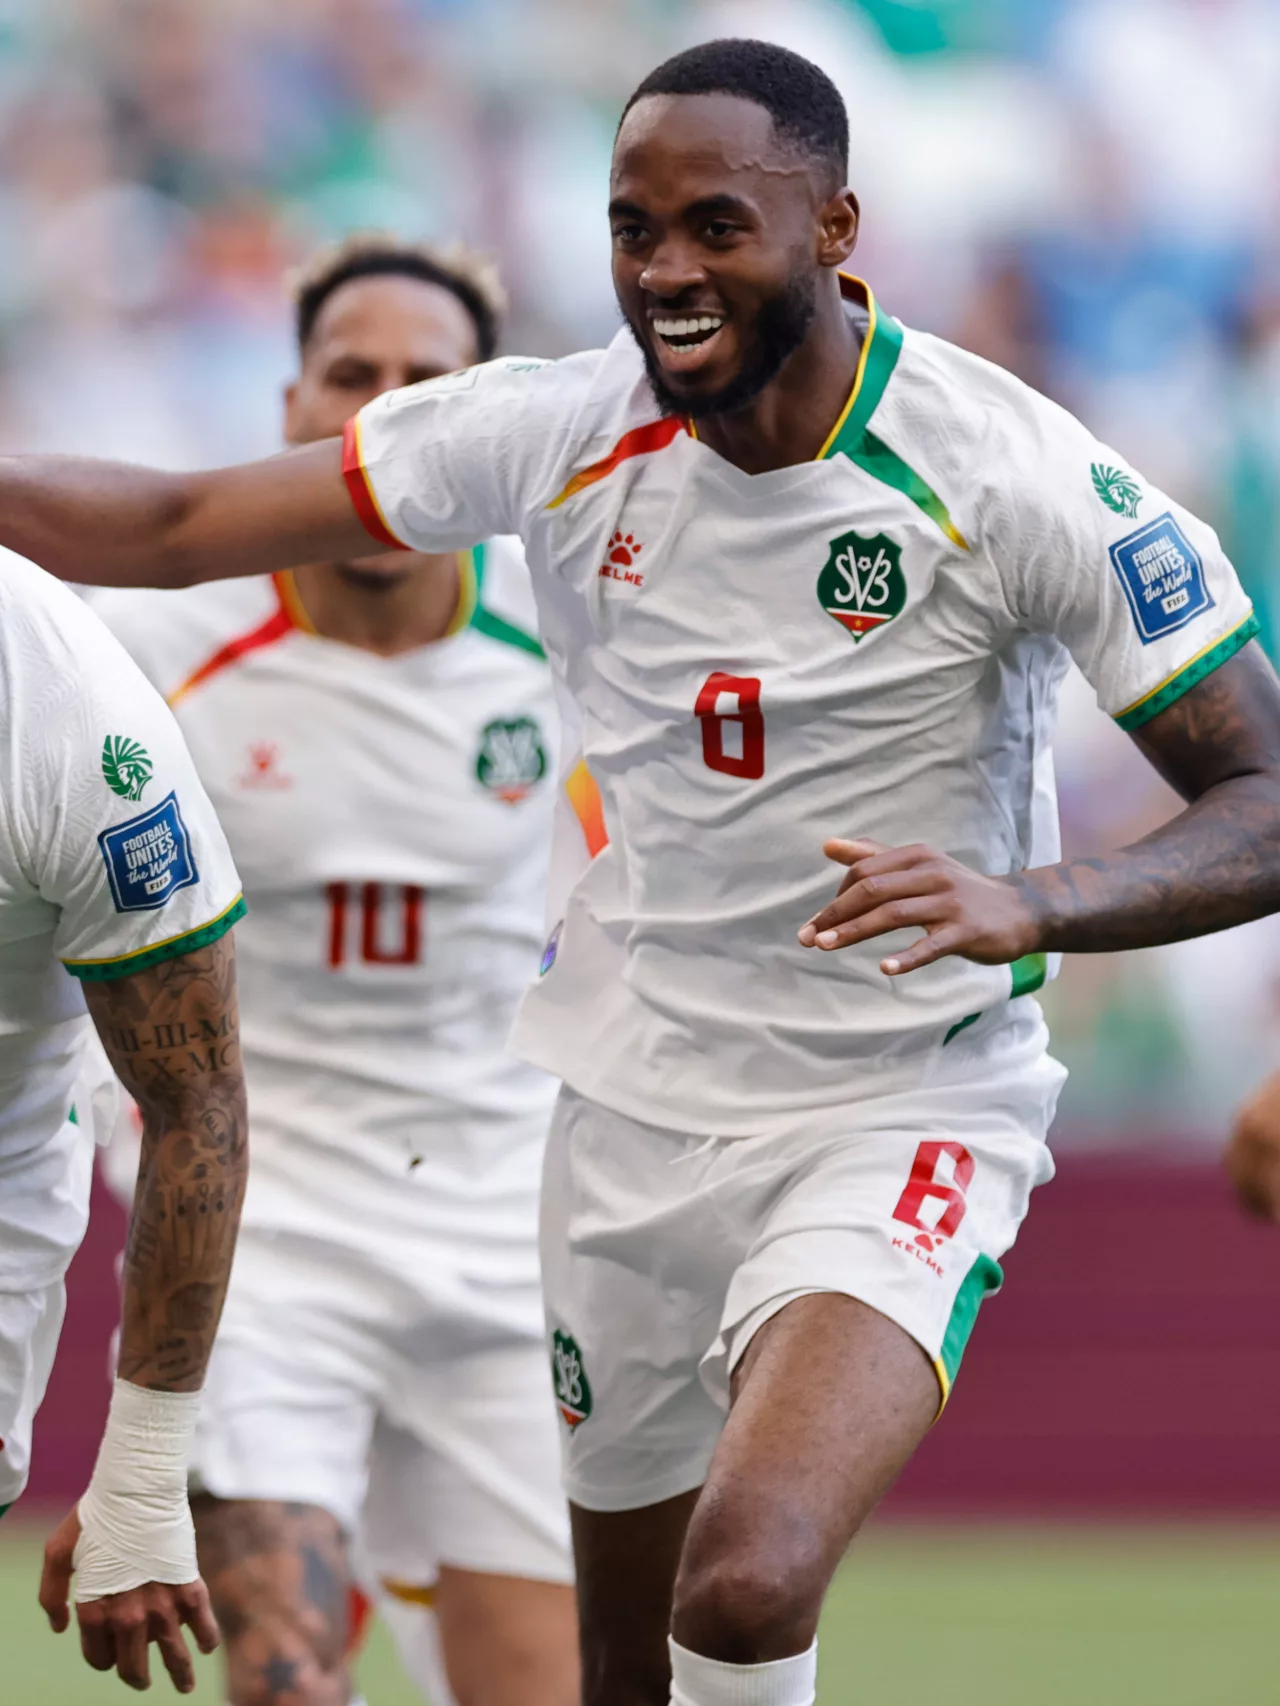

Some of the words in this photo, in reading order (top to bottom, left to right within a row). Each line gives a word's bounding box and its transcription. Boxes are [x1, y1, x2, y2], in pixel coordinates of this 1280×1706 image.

[1132, 535, 1176, 568] FOOTBALL
[1138, 547, 1185, 586] UNITES
[599, 564, 644, 587] ELME
[1142, 584, 1163, 604] the
[1162, 562, 1193, 593] World
[1167, 594, 1186, 609] FIFA
[694, 671, 765, 780] 8
[122, 819, 171, 853] FOOTBALL
[125, 831, 175, 870] UNITES
[126, 868, 149, 884] the
[148, 844, 179, 877] World
[149, 876, 169, 891] FIFA
[324, 880, 426, 970] 10
[891, 1236, 945, 1279] KELME
